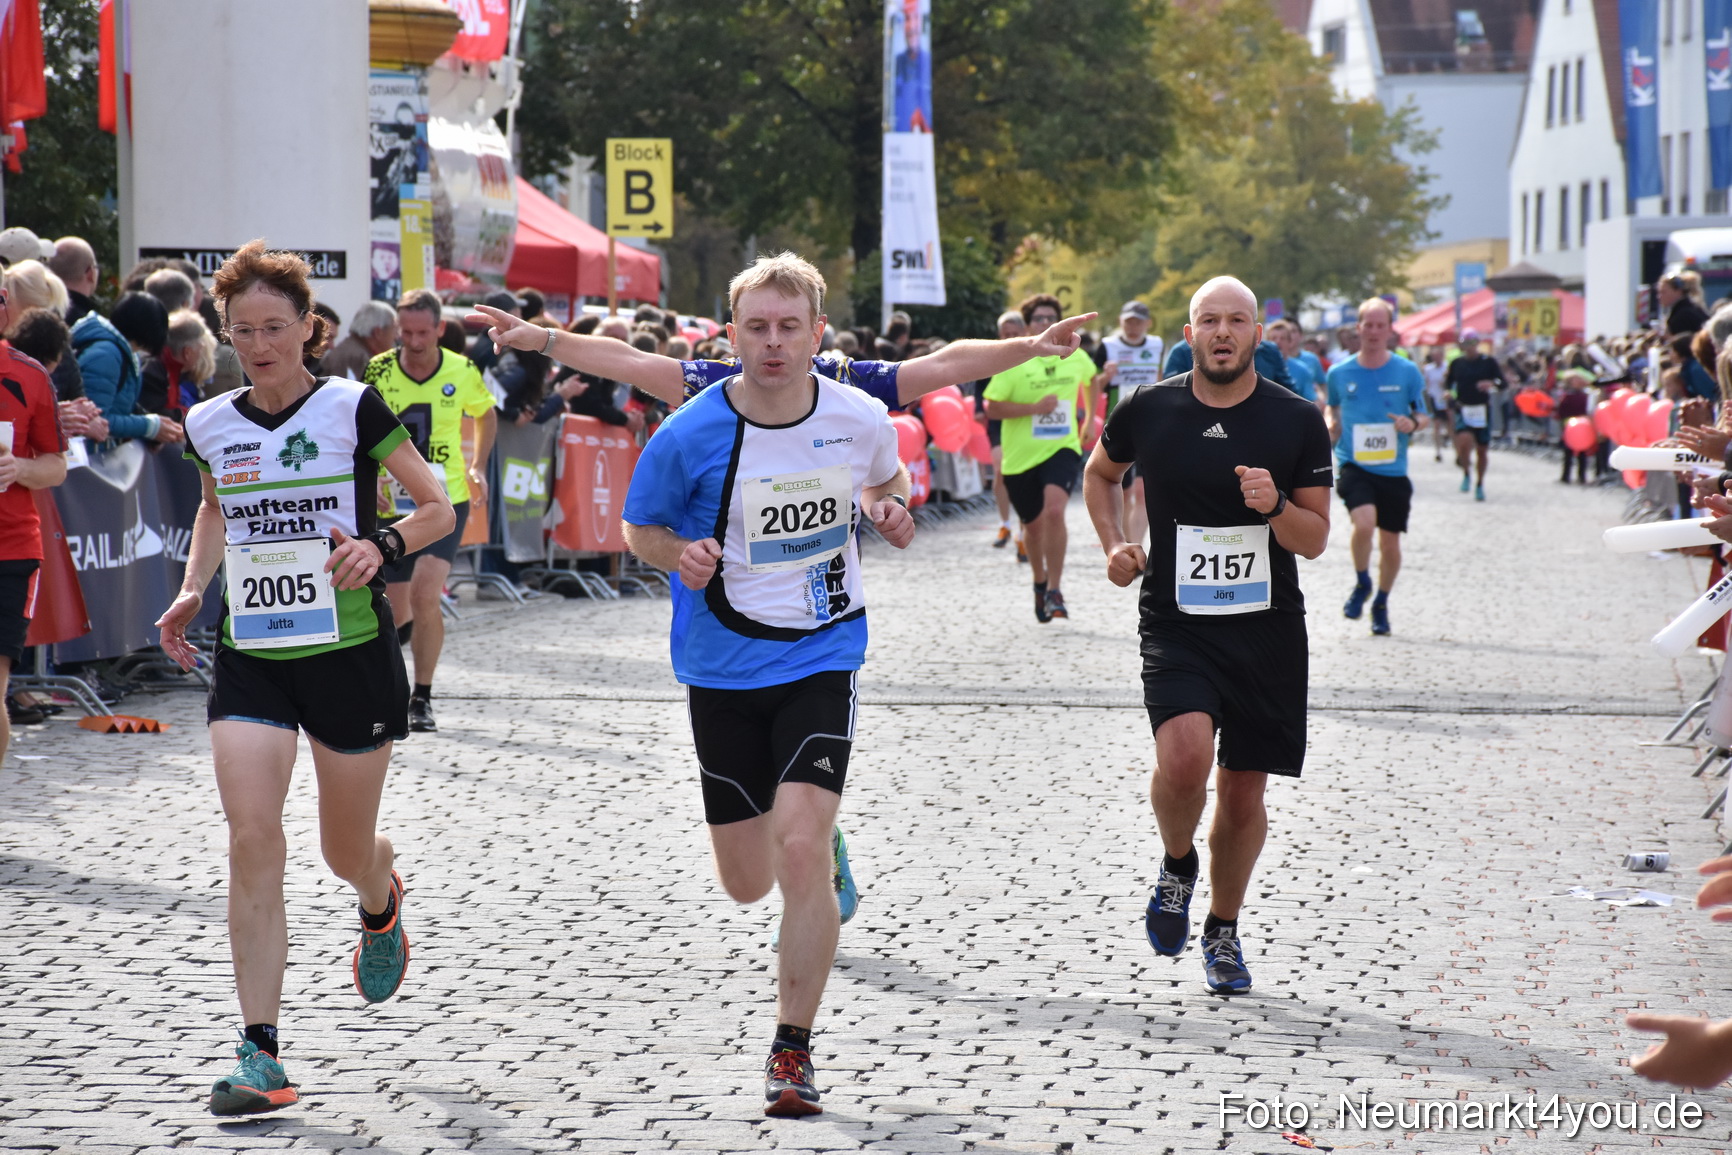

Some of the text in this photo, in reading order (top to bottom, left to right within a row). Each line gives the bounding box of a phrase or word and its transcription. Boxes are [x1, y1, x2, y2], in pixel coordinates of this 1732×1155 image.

[615, 144, 664, 161] Block
[625, 170, 655, 215] B
[1203, 431, 1228, 439] adidas
[1364, 437, 1387, 449] 409
[221, 470, 262, 486] OBI
[783, 478, 822, 492] BOCK
[221, 495, 339, 520] Laufteam
[760, 497, 837, 535] 2028
[247, 517, 316, 537] Fürth
[781, 538, 821, 554] Thomas
[1212, 534, 1243, 544] BOCK
[260, 551, 298, 563] BOCK
[1190, 552, 1256, 580] 2157
[243, 573, 317, 609] 2005
[1213, 590, 1235, 601] Jörg
[267, 618, 294, 630] Jutta
[813, 761, 835, 774] adidas
